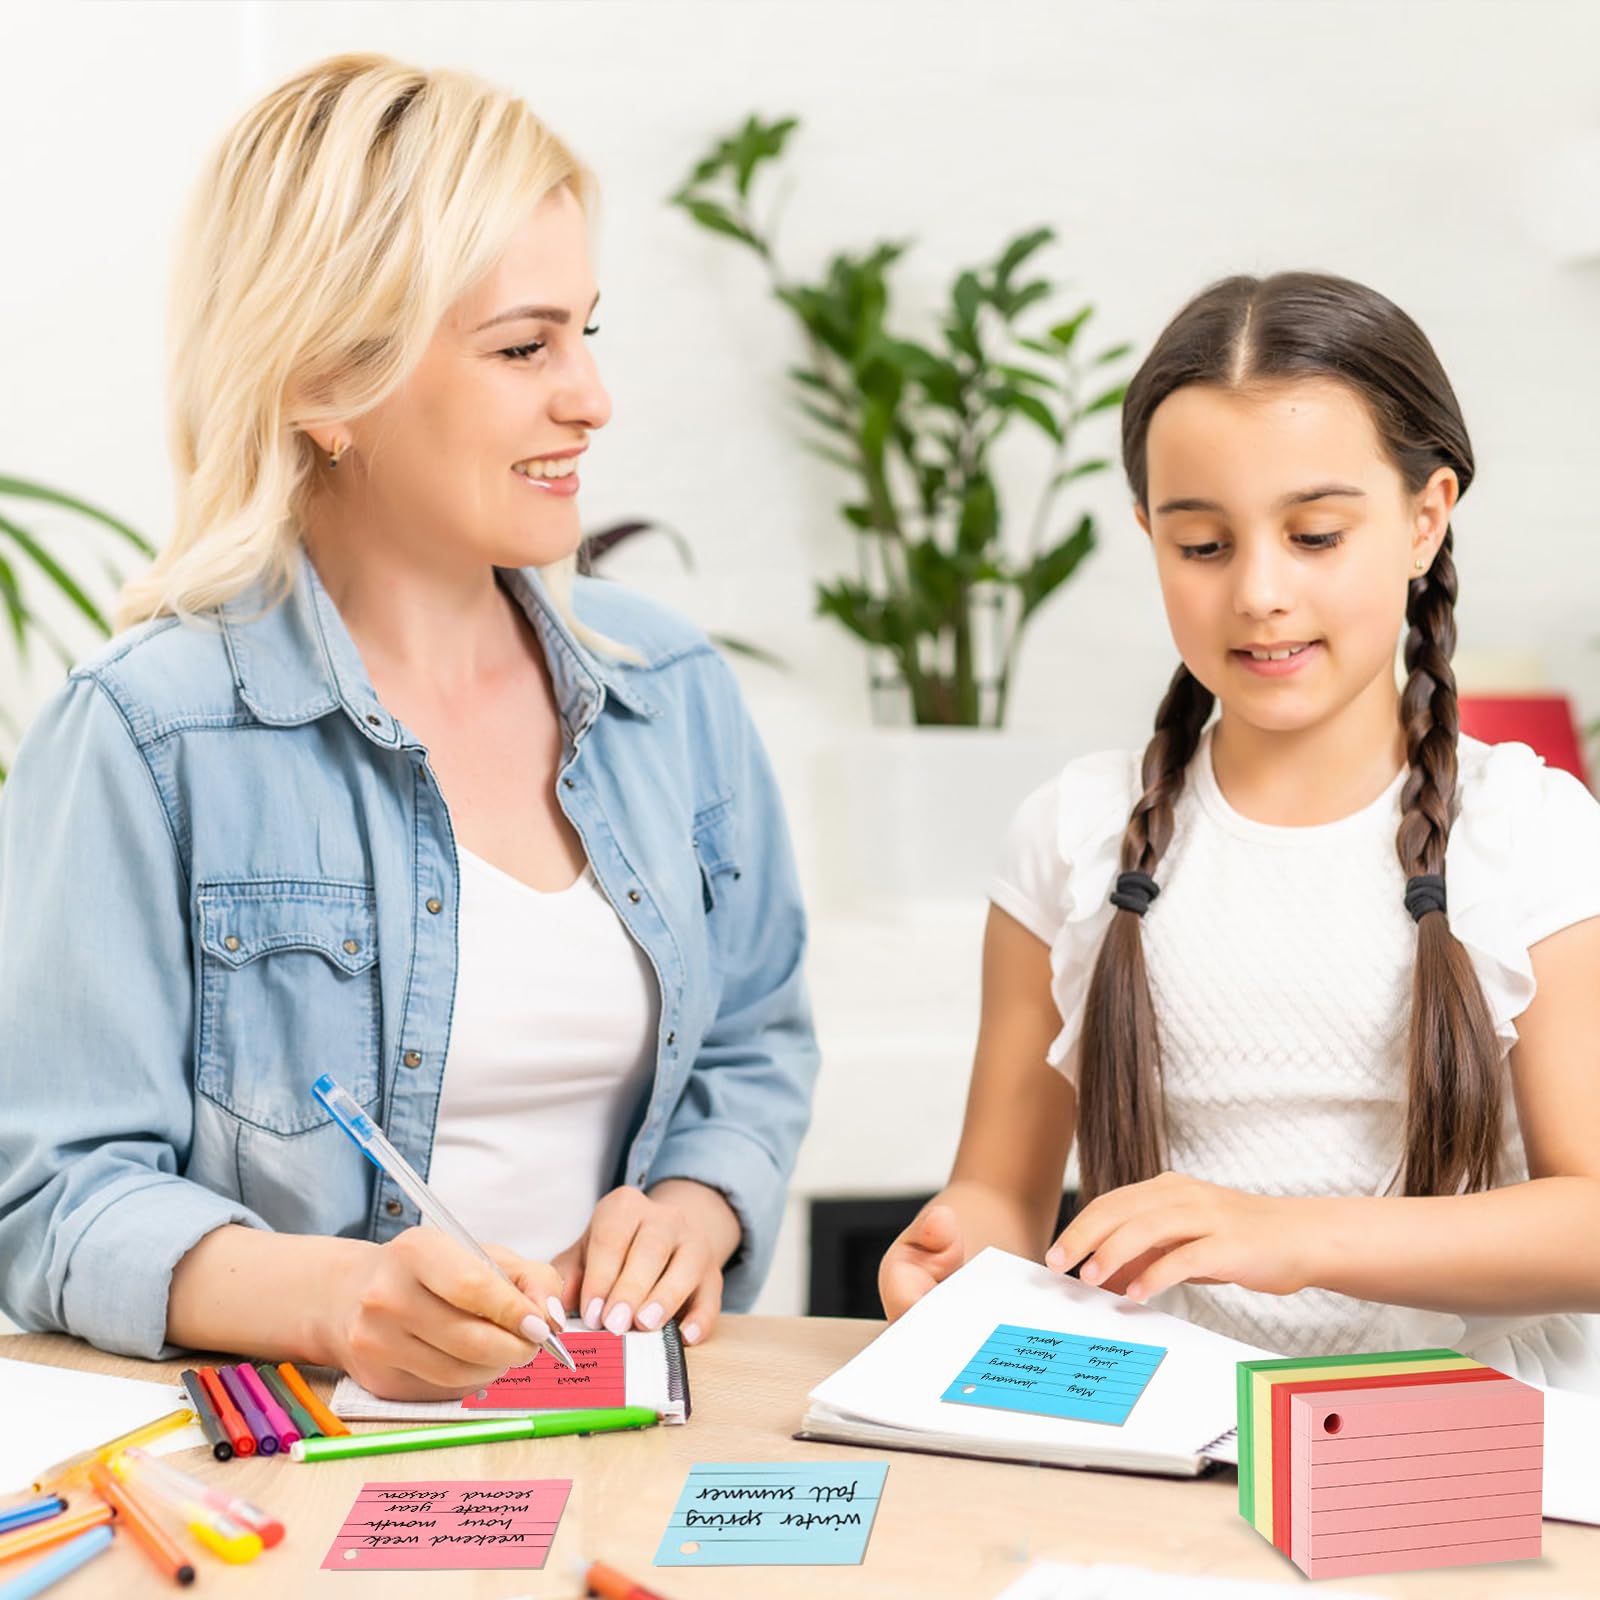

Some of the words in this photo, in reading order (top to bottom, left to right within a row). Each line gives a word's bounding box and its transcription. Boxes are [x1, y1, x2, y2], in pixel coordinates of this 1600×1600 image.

[1026, 1335, 1063, 1347] April
[1014, 1348, 1057, 1360] March
[1088, 1344, 1134, 1357] August
[988, 1357, 1047, 1374] February
[1088, 1356, 1119, 1368] July
[980, 1372, 1038, 1388] January
[1073, 1372, 1107, 1383] June
[1066, 1384, 1096, 1397] May
[378, 1490, 449, 1500] season
[459, 1489, 534, 1502] second
[696, 1486, 795, 1501] summer
[809, 1480, 858, 1503] fall
[384, 1501, 433, 1513] year
[364, 1519, 437, 1531] month
[458, 1518, 513, 1530] hour
[686, 1509, 763, 1532] spring
[779, 1512, 861, 1532] winter
[362, 1535, 420, 1547] week
[428, 1534, 525, 1547] weekend
